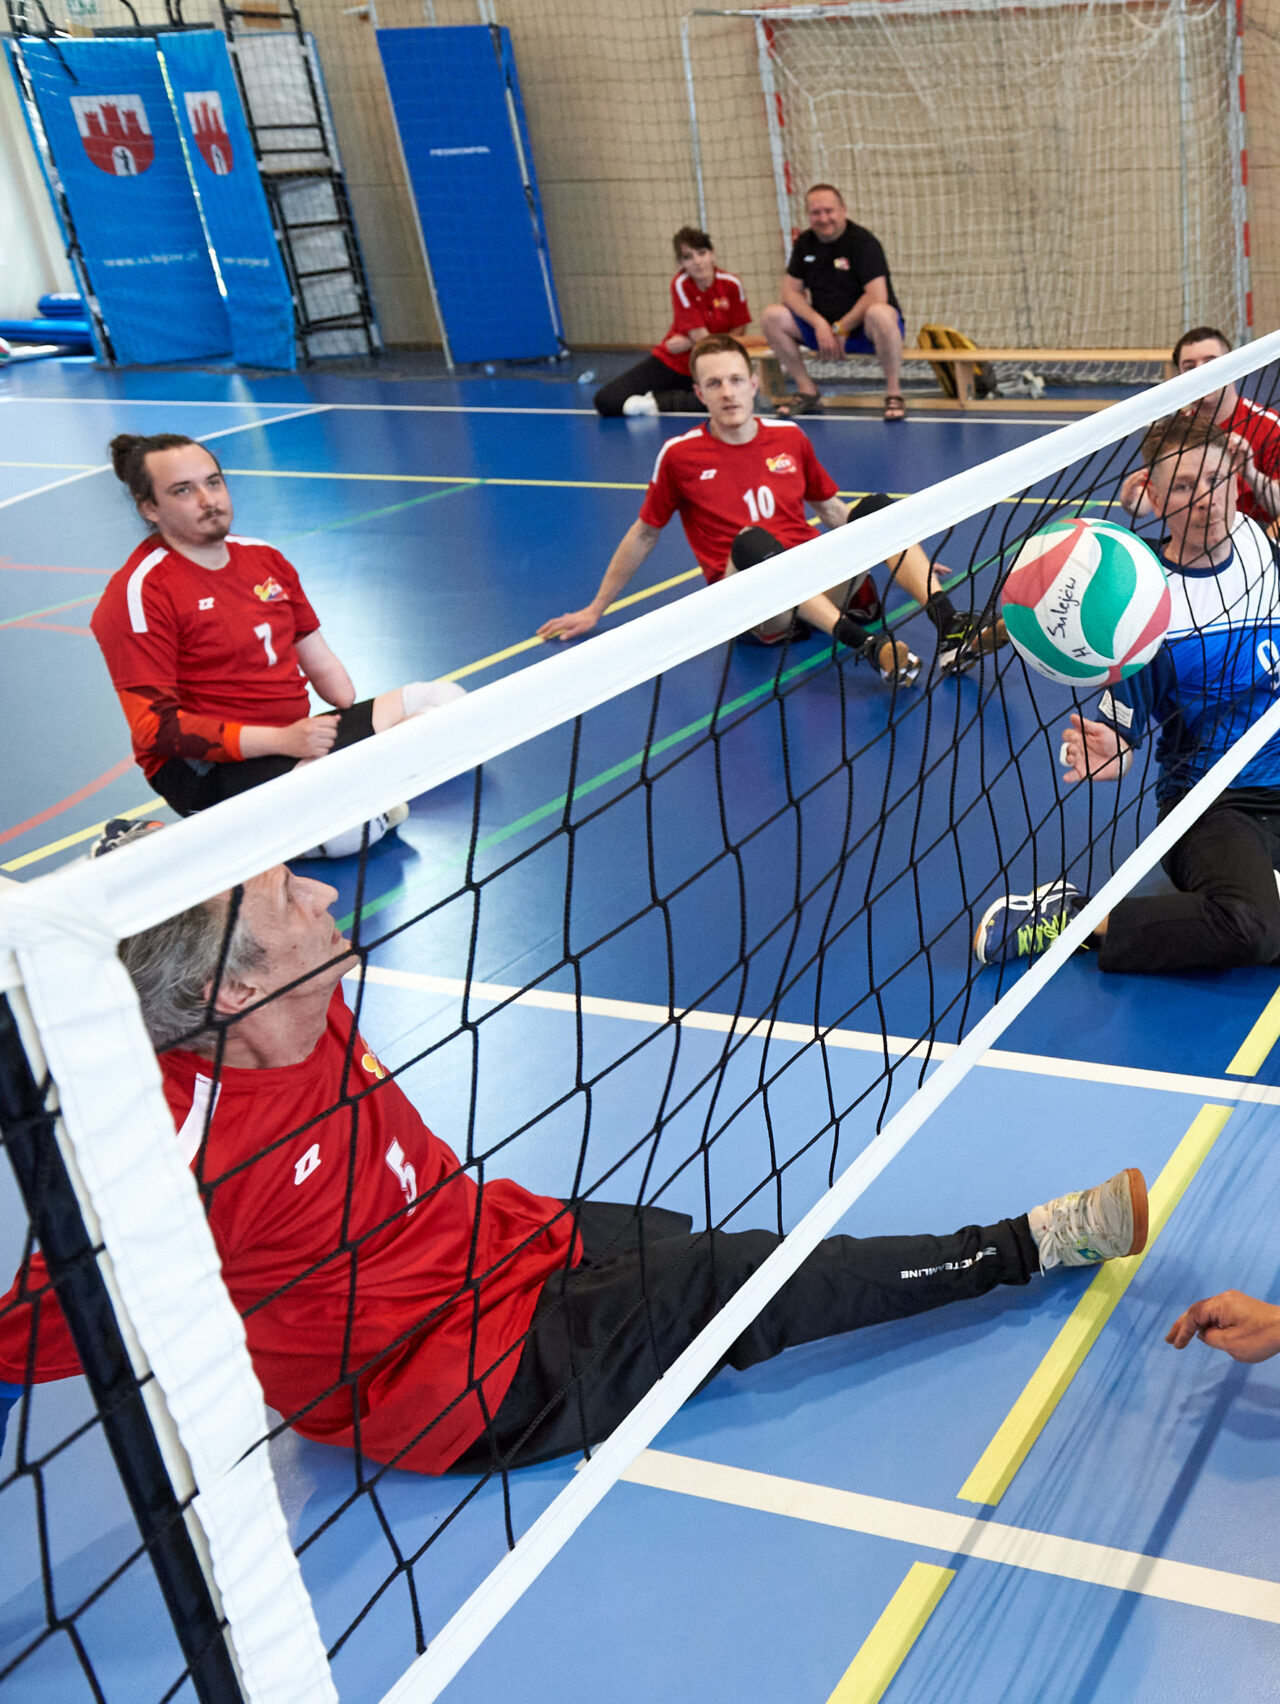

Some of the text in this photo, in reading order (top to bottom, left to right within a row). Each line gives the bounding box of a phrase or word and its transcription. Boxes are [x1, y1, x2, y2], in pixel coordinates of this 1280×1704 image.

[742, 485, 776, 523] 10
[253, 622, 278, 666] 7
[385, 1135, 418, 1217] 5
